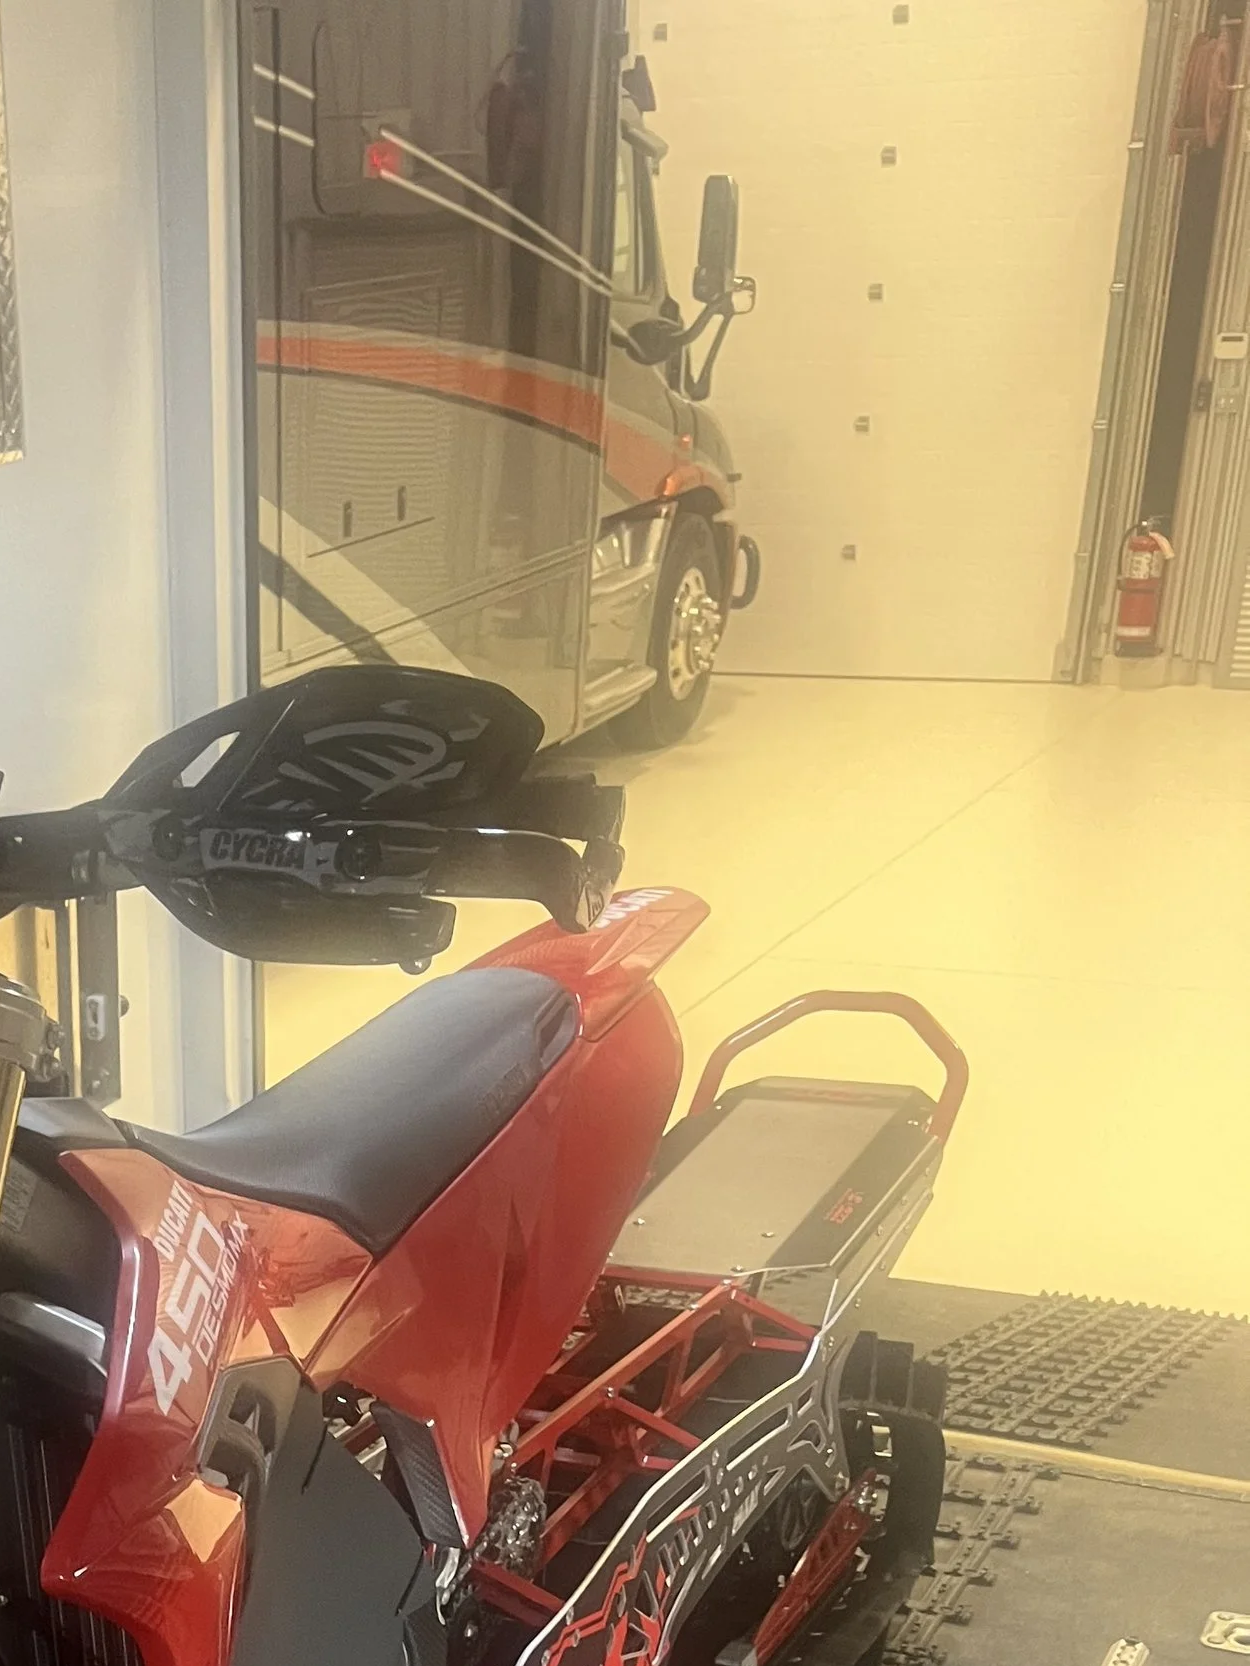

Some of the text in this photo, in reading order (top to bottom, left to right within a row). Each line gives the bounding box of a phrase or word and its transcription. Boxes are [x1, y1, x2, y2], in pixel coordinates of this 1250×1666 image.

[209, 831, 306, 869] CYCRA
[153, 1180, 194, 1263] DUCATI
[147, 1210, 226, 1417] 450
